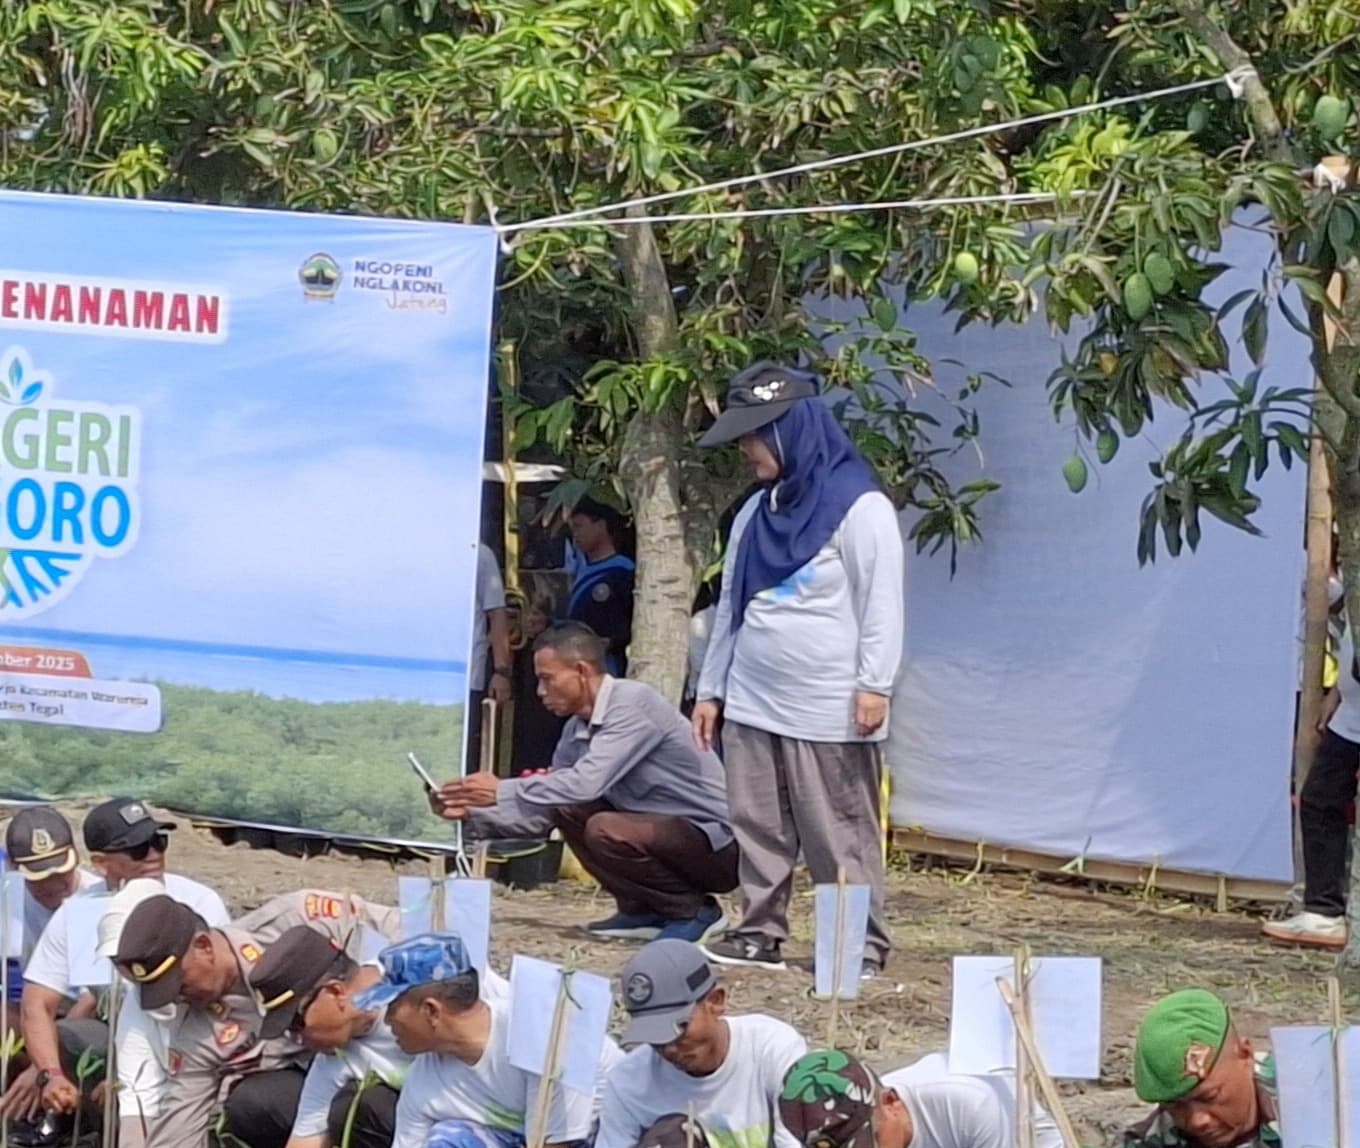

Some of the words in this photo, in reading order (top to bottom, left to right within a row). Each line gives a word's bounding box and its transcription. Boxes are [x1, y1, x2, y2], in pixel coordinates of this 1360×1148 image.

[354, 260, 433, 278] NGOPENI
[353, 276, 446, 295] NGLAKONI
[36, 654, 76, 671] 2025
[20, 685, 88, 700] Kecamatan
[30, 702, 65, 717] Tegal
